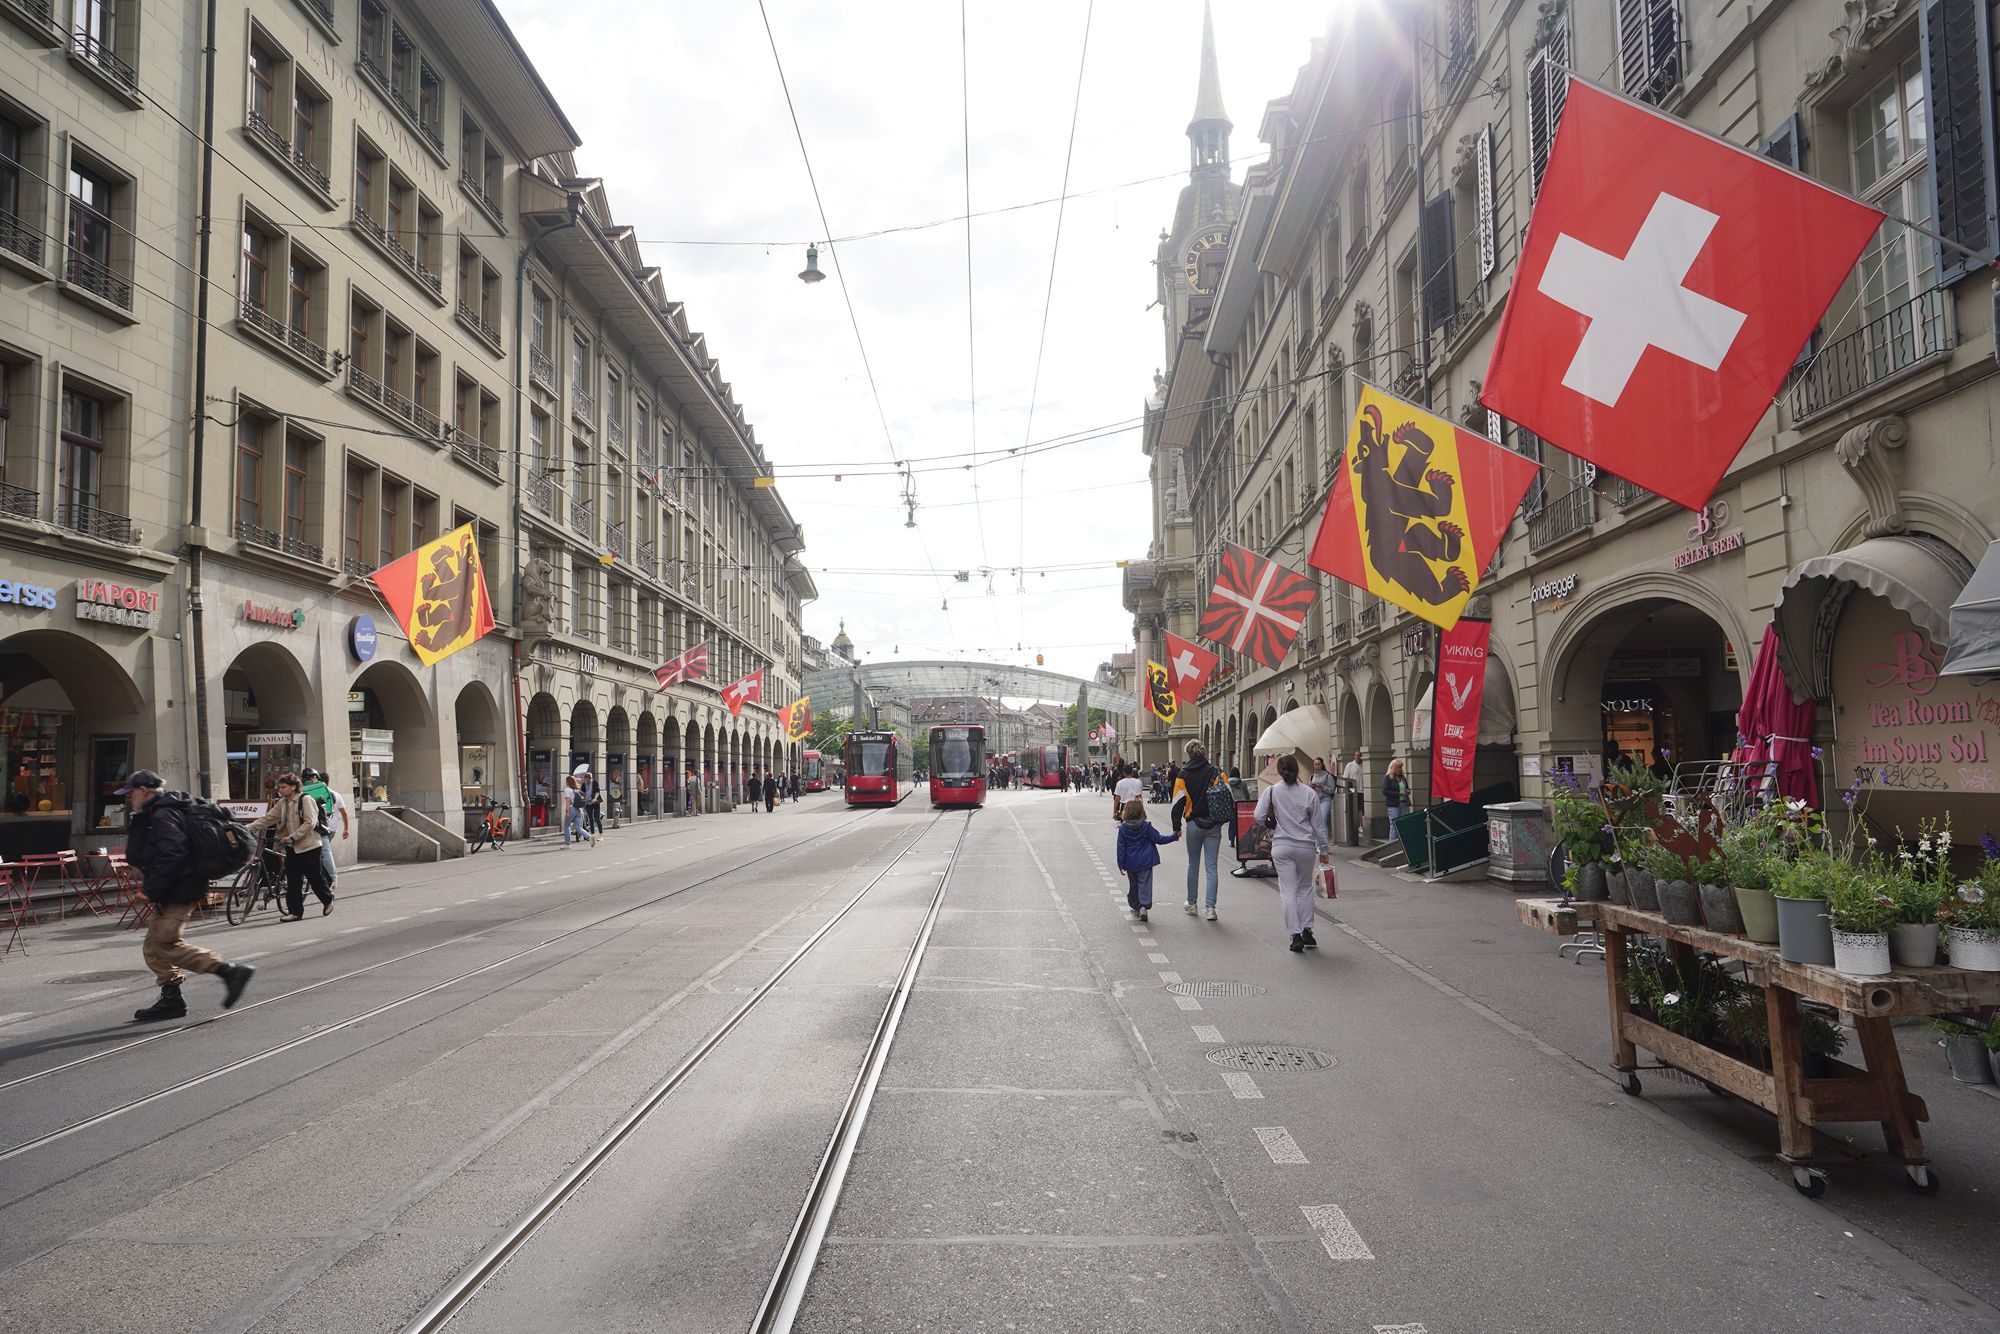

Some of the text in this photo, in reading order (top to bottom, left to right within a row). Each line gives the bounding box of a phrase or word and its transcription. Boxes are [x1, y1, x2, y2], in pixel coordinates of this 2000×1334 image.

[1673, 533, 1743, 570] BEELER BERN
[83, 579, 159, 612] IMPORT
[83, 602, 159, 630] PARFUMERIE
[1403, 632, 1424, 656] KURZ
[1444, 645, 1484, 658] VIKING
[580, 653, 599, 674] LOEB
[1868, 700, 1902, 727] Tea
[1905, 697, 1972, 725] Room
[1444, 724, 1465, 739] LEONE
[1861, 730, 1988, 764] im Sous Sol
[1441, 757, 1463, 767] SPORTS
